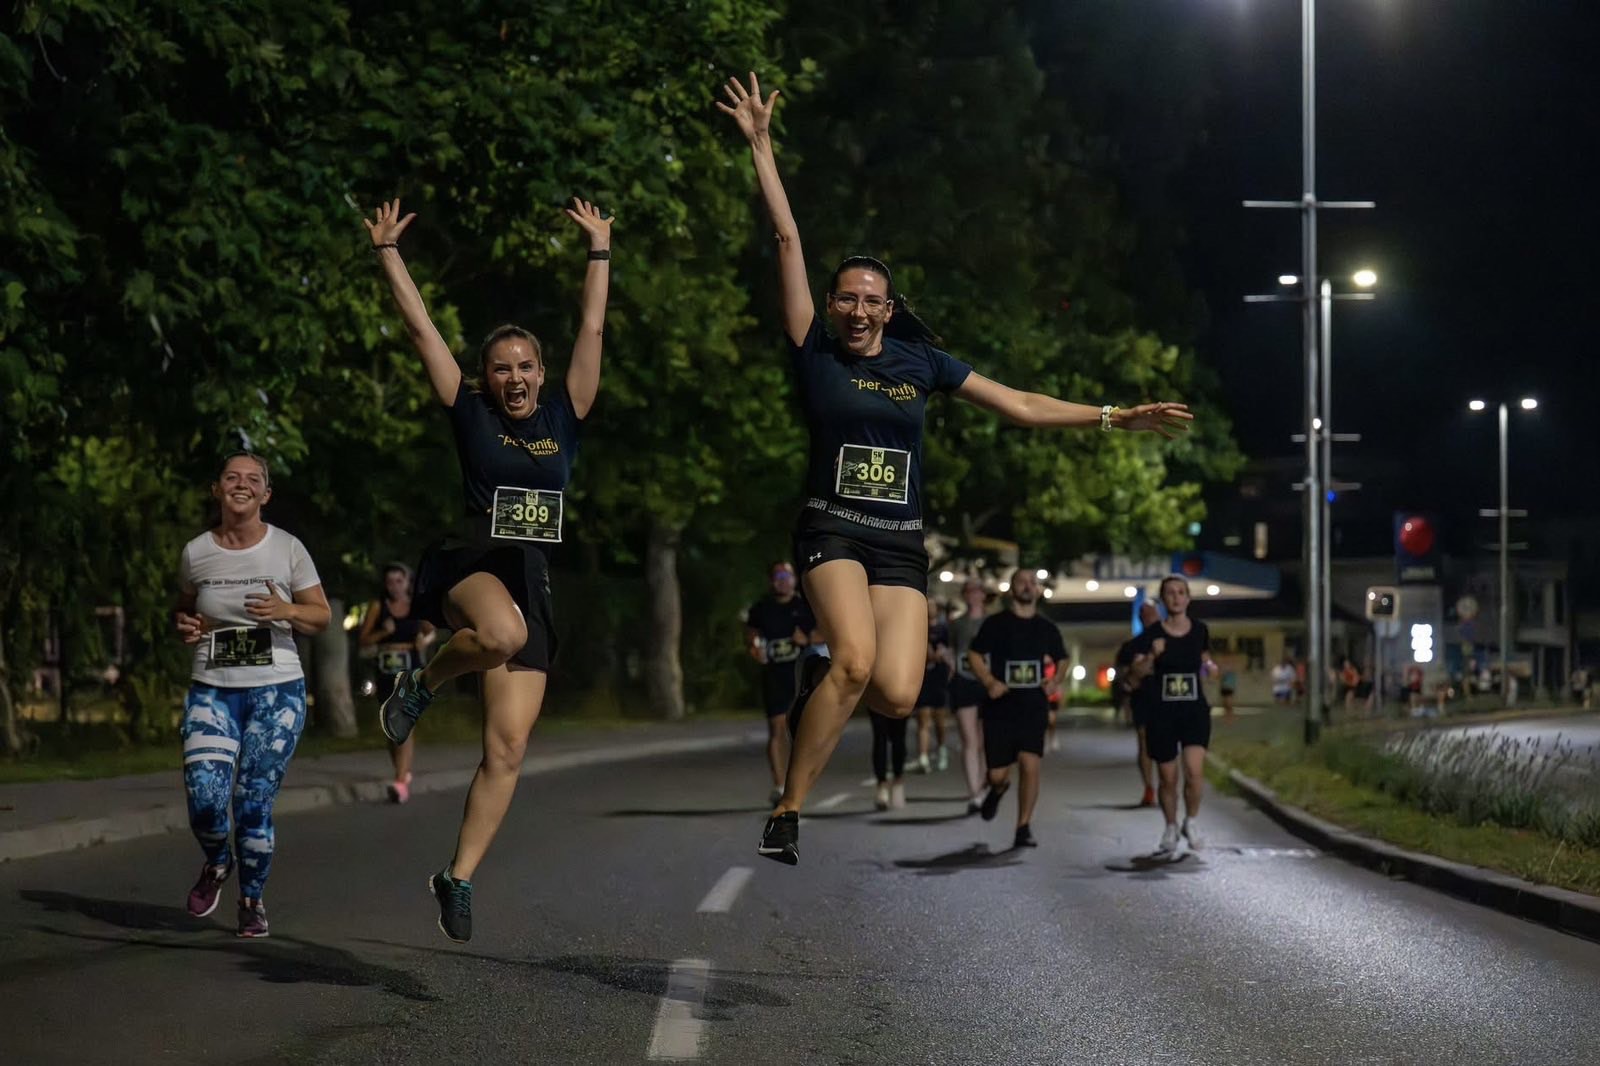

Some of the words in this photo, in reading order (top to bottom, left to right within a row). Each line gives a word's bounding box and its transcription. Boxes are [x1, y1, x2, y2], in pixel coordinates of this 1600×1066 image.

[856, 462, 896, 484] 306
[512, 503, 549, 523] 309
[860, 514, 901, 531] ARMOUR
[229, 640, 257, 655] 147
